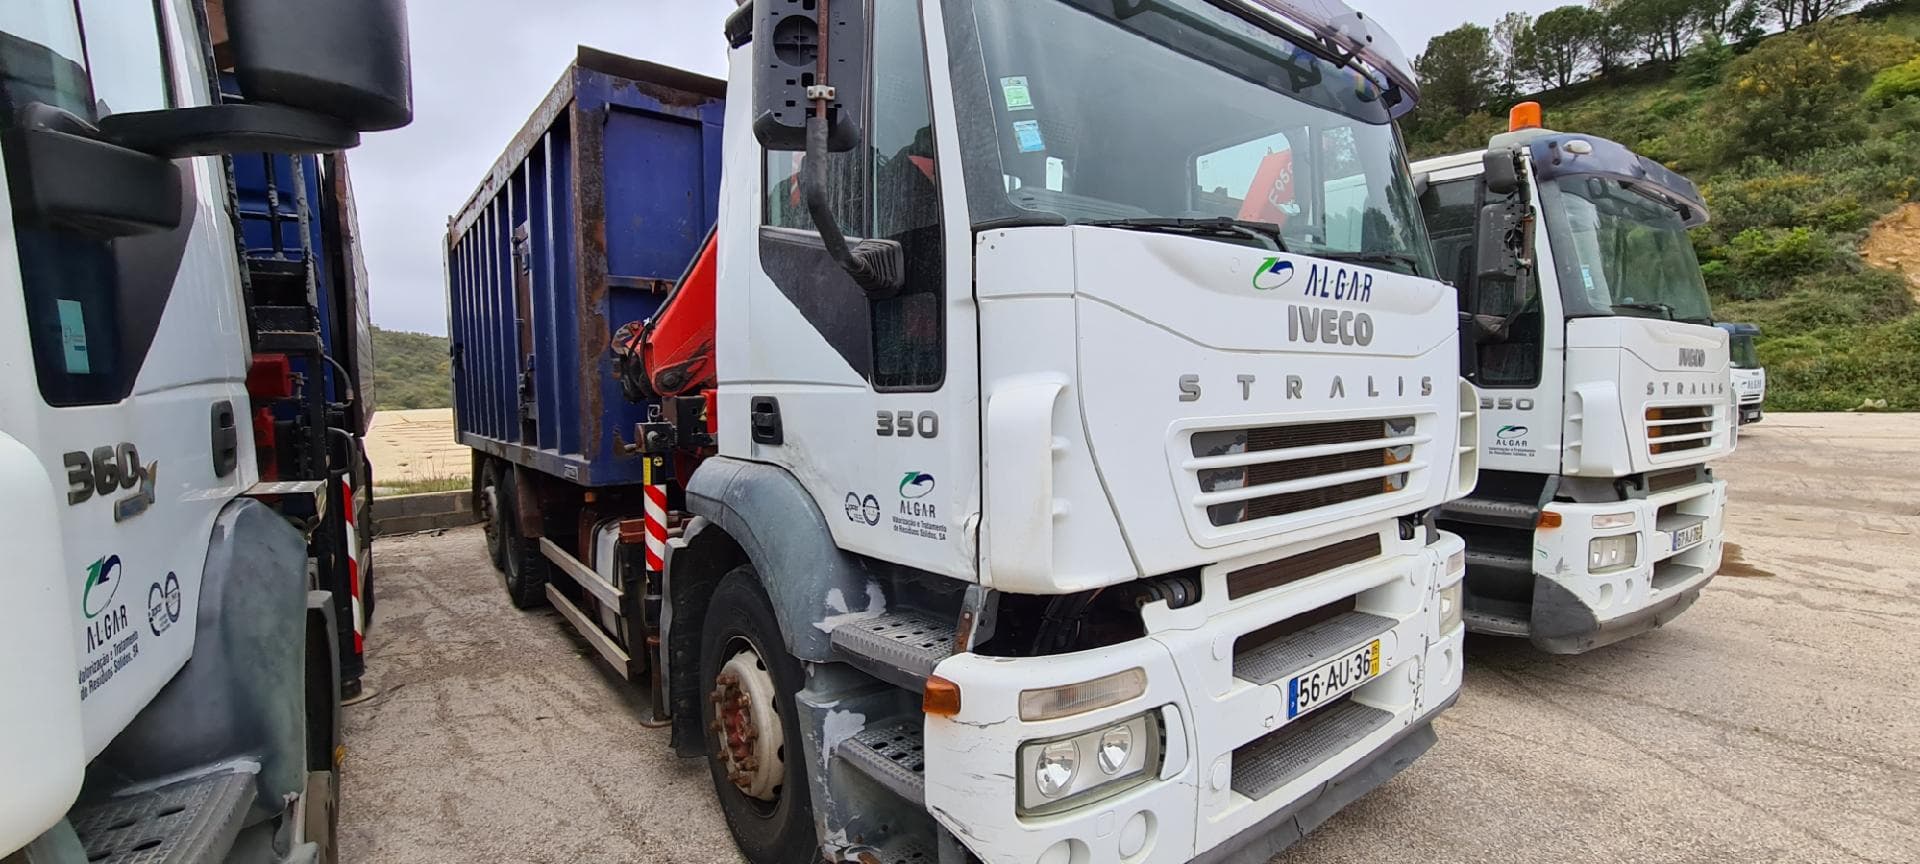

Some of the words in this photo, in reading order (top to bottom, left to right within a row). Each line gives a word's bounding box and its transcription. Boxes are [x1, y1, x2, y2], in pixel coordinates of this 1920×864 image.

[1304, 264, 1373, 302] ALGAR
[1287, 304, 1374, 346] IVECO
[1678, 347, 1706, 368] IVECO
[1178, 374, 1432, 402] STRALIS
[1646, 381, 1724, 396] STRALIS
[1480, 396, 1534, 411] 350
[876, 409, 939, 439] 350
[63, 441, 140, 506] 360
[900, 499, 936, 519] ALGAR
[87, 604, 128, 653] ALGAR
